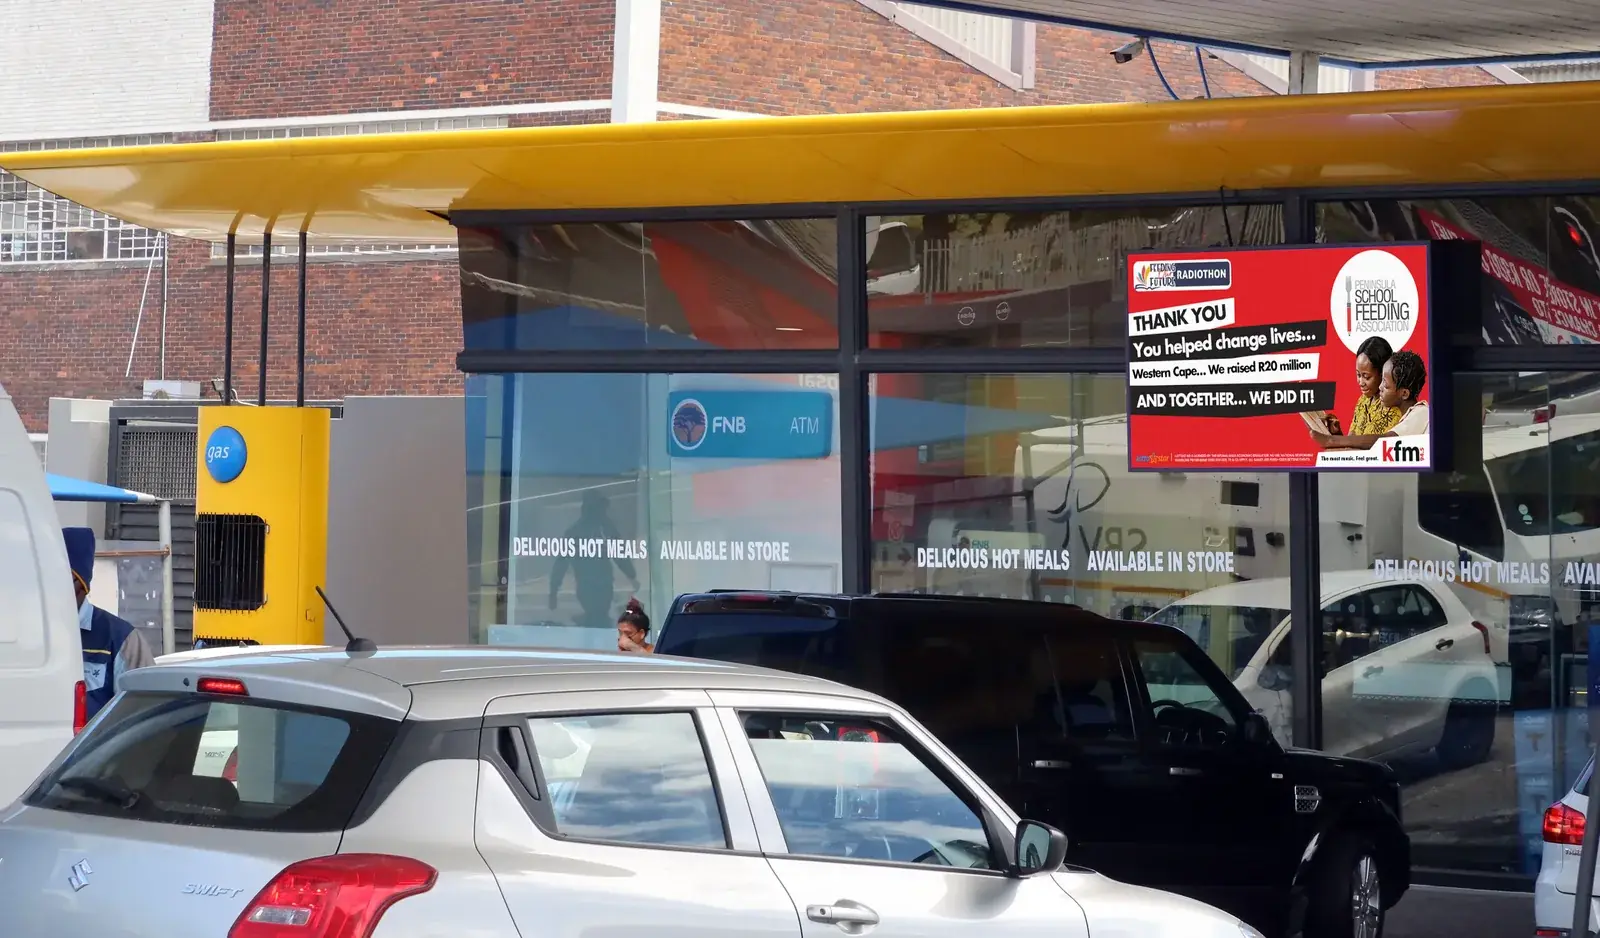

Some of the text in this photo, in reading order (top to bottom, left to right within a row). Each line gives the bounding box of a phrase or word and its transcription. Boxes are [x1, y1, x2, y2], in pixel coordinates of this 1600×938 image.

[1176, 269, 1227, 280] RADIOTHON
[1355, 279, 1396, 289] PENINSULA
[1355, 289, 1397, 303] SCHOOL
[1133, 304, 1226, 332] THANK YOU
[1356, 302, 1410, 321] FEEDING
[1356, 320, 1409, 332] ASSOCIATION
[1133, 327, 1316, 358] You helped change lives...
[1132, 359, 1311, 379] Western Cape... We raised R20 million
[1136, 389, 1315, 409] AND TOGETHER... WE DID IT!
[712, 416, 746, 434] FNB
[789, 416, 819, 434] ATM
[207, 446, 230, 463] gas
[1382, 440, 1420, 462] kfm
[513, 537, 790, 562] DELICIOUS HOT MEALS AVAILABLE IN STORE
[917, 547, 1235, 573] DELICIOUS HOT MEALS AVAILABLE IN STORE
[1374, 559, 1455, 582] DELICIOUS
[1460, 561, 1492, 583] HOT
[1497, 561, 1549, 584] MEALS
[181, 882, 244, 898] SWIFT
